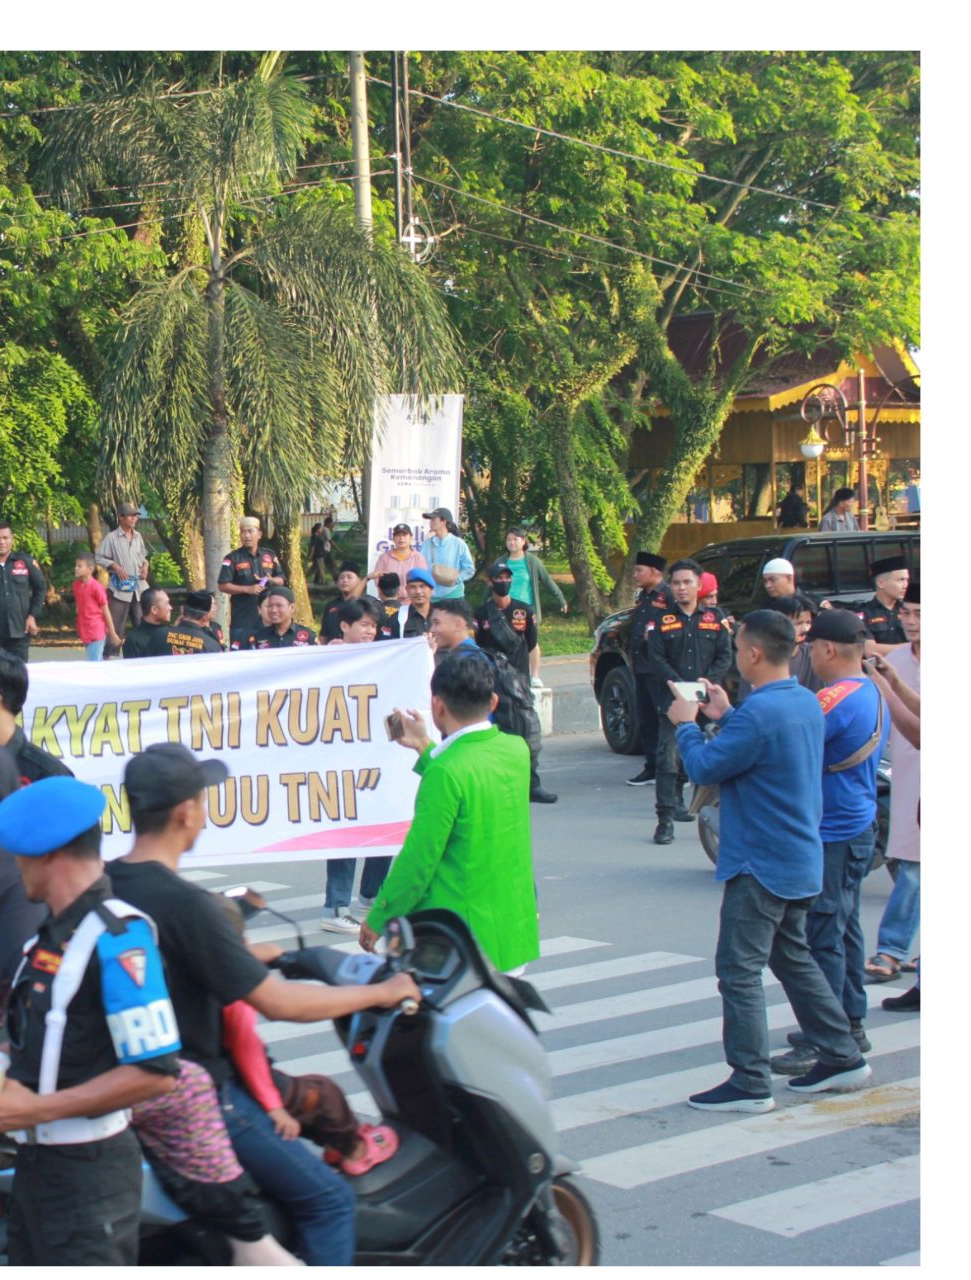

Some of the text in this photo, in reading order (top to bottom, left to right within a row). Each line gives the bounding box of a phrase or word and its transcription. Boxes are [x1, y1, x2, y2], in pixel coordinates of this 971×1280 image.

[15, 683, 378, 759] KYAT TNI KUAT
[202, 774, 270, 830] UU
